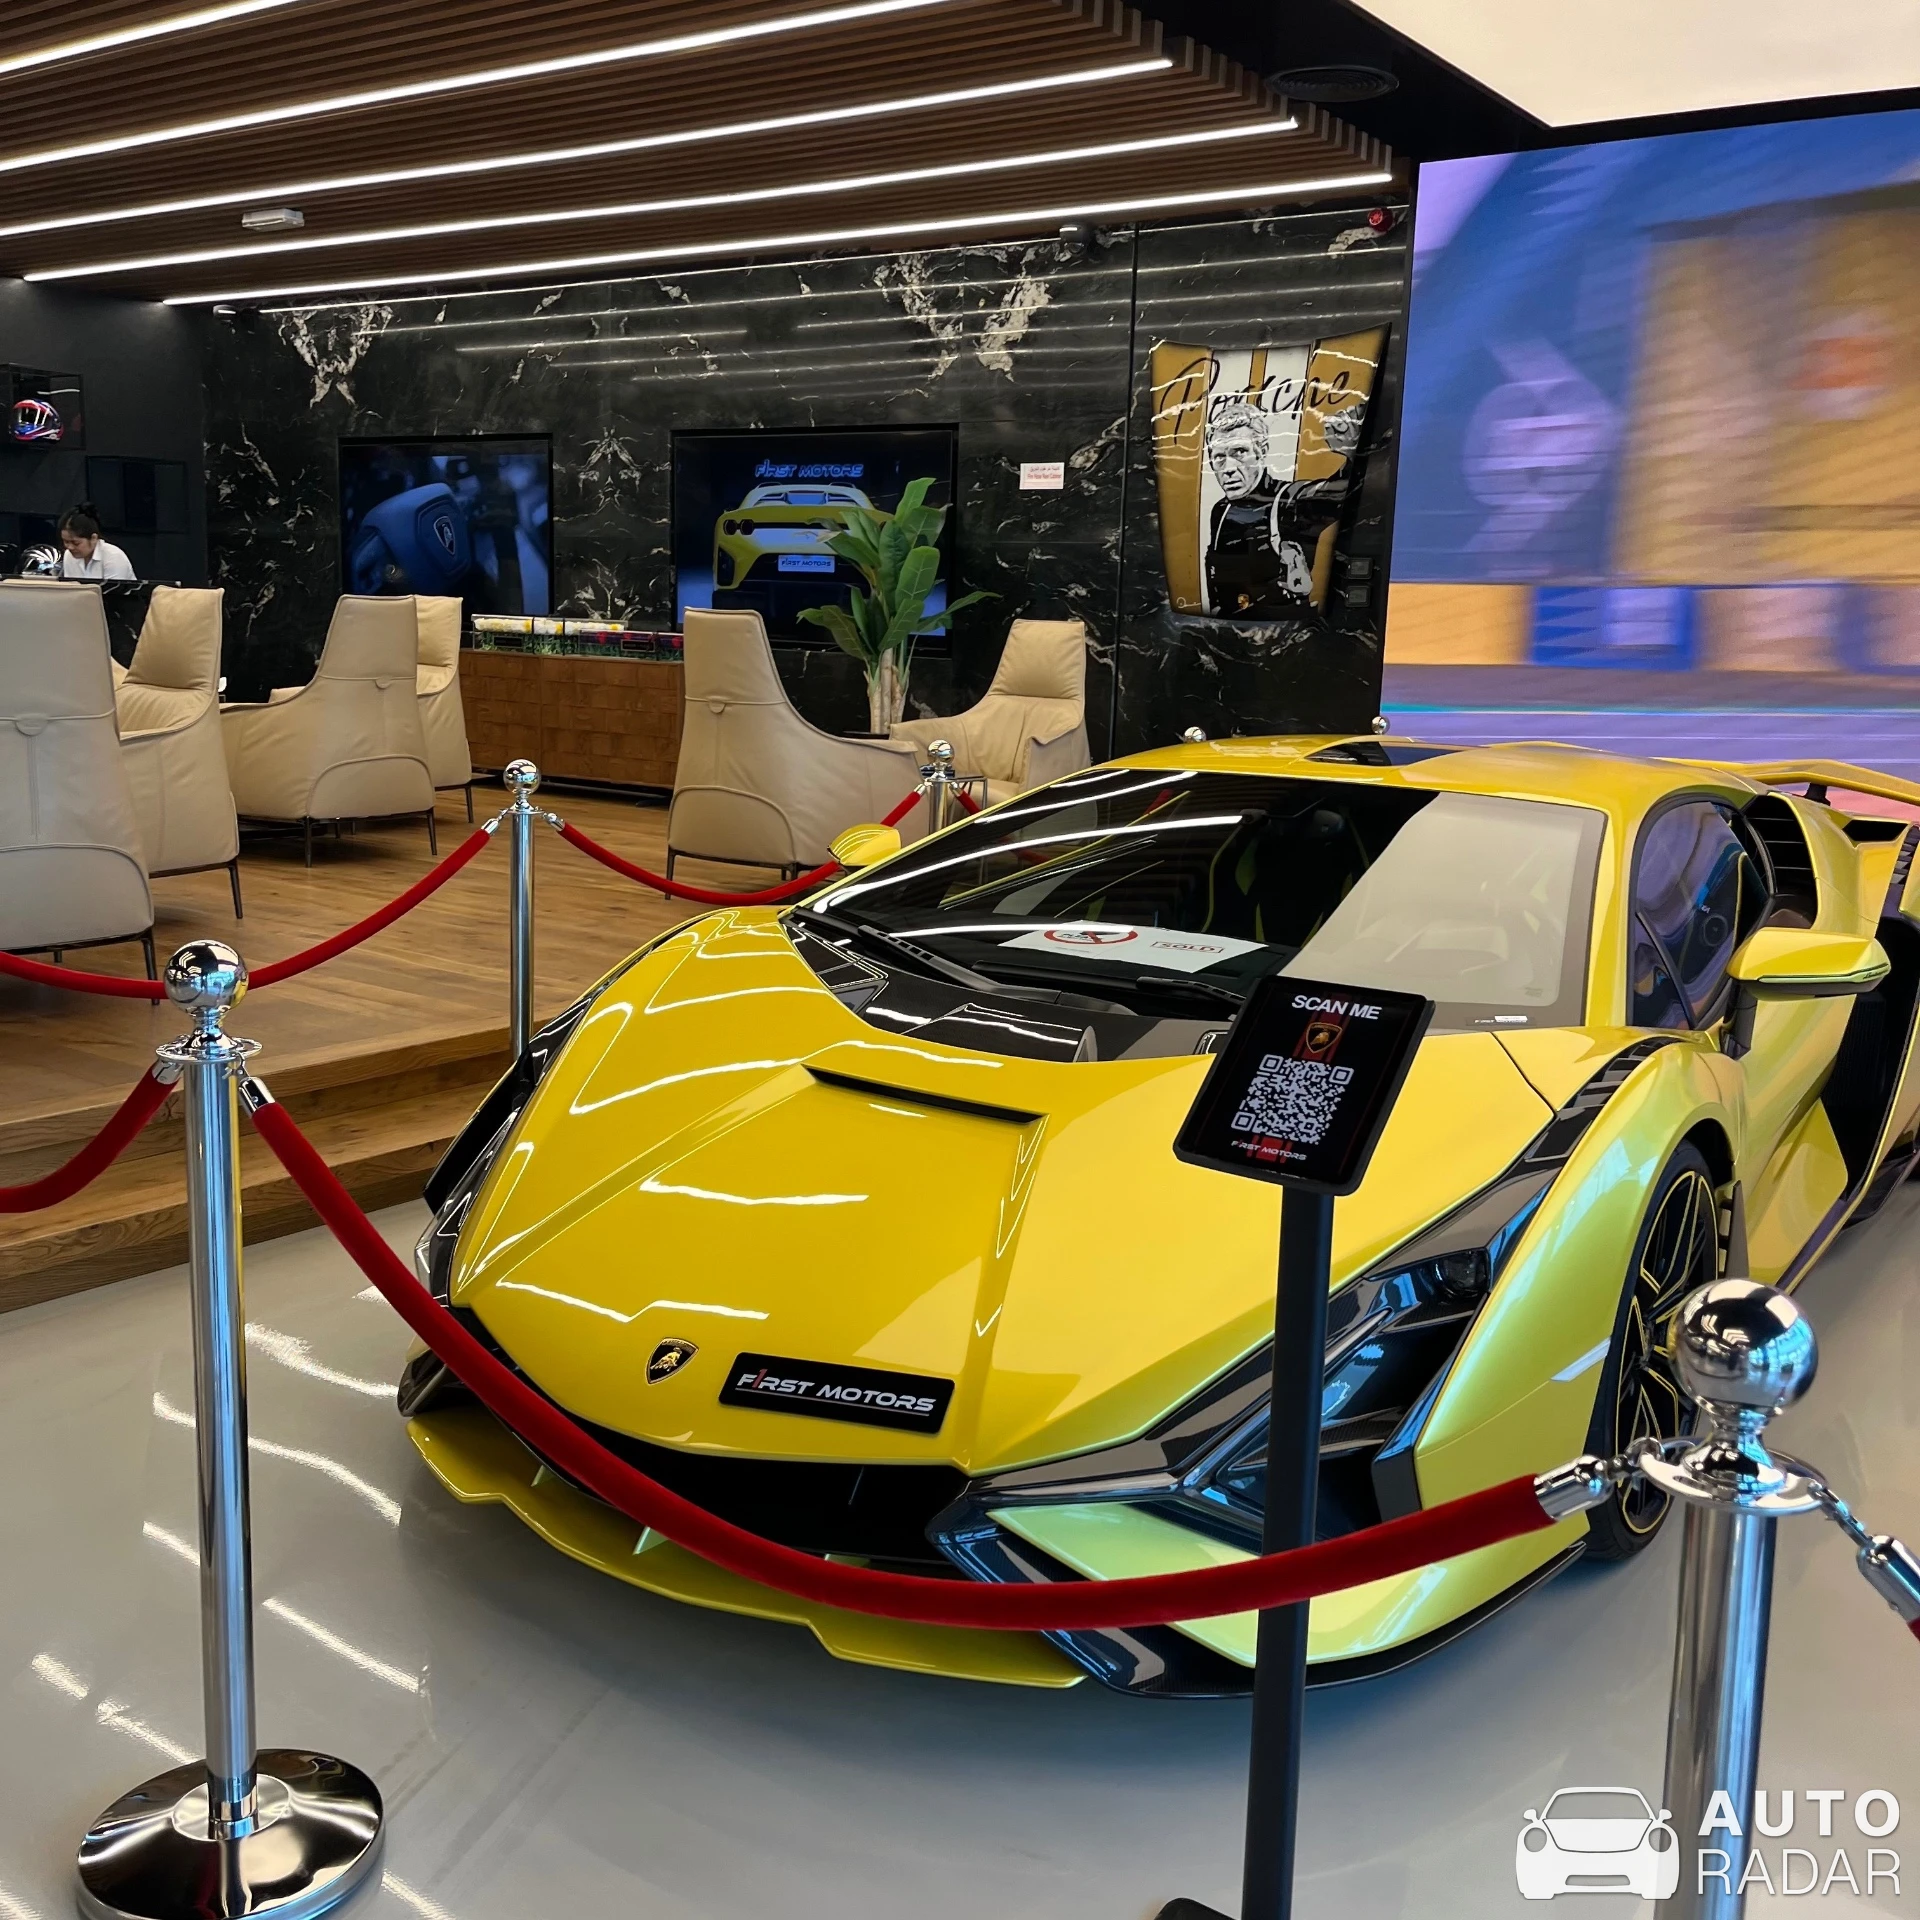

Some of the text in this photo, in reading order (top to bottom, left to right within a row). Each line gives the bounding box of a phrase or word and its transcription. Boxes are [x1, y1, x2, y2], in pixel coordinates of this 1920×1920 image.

[798, 464, 864, 478] MOTORS
[1161, 942, 1216, 952] SOLD
[1291, 995, 1383, 1020] SCAN ME
[1261, 1146, 1308, 1161] MOTORS
[816, 1384, 937, 1412] MOTORS
